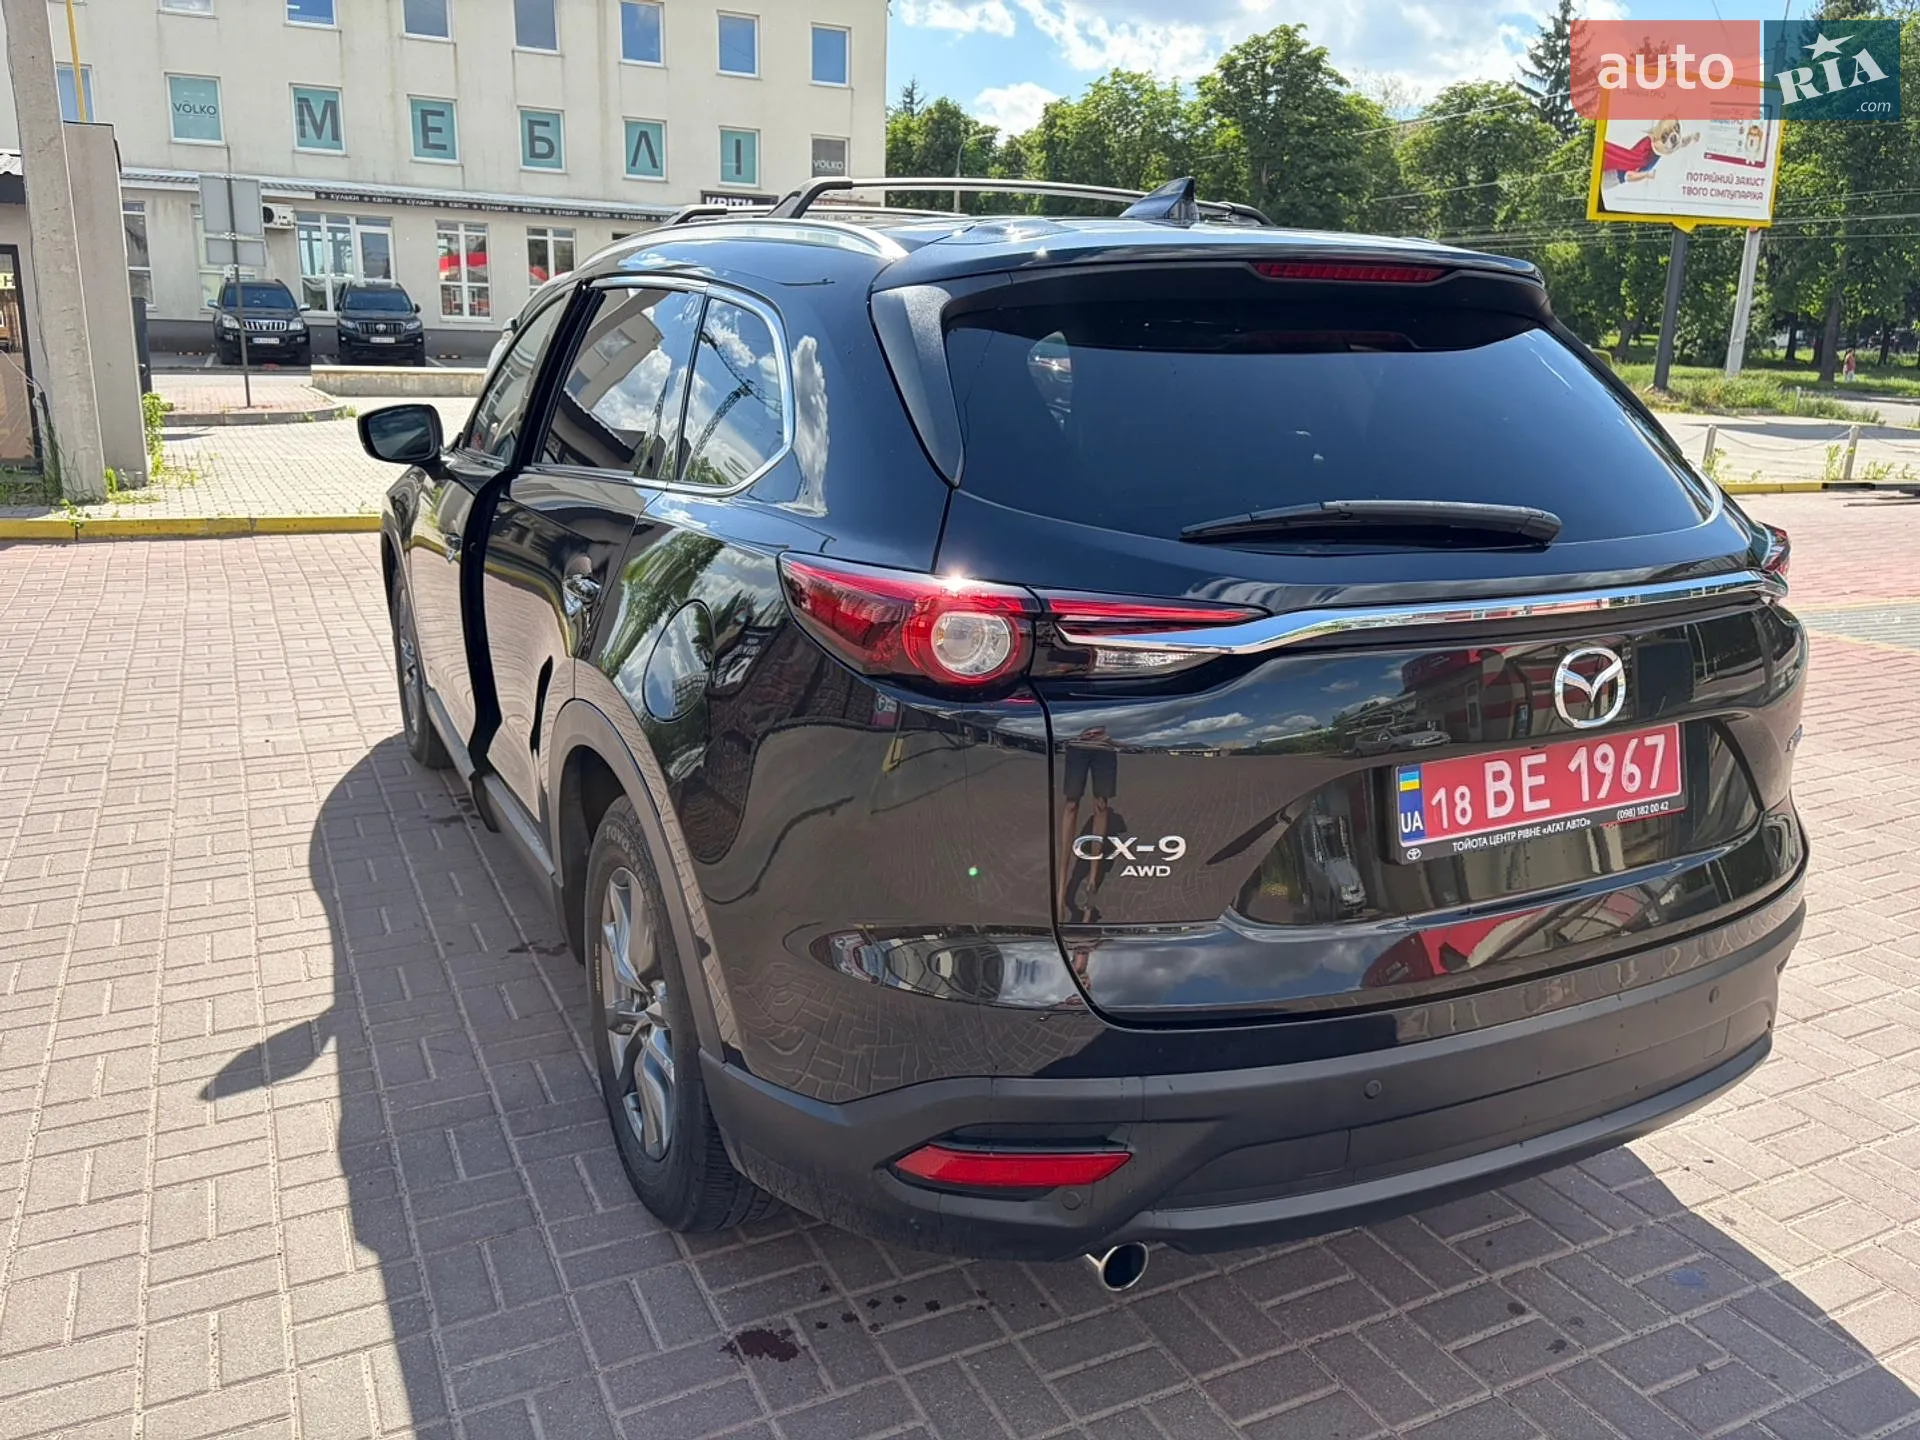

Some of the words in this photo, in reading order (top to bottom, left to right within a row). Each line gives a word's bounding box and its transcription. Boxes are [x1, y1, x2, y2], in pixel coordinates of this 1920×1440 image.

[1682, 186, 1708, 196] ТВОГО
[1431, 785, 1472, 829] 18
[1567, 734, 1665, 802] 1967
[1637, 804, 1649, 815] 182
[1660, 801, 1669, 811] 42
[1400, 811, 1424, 833] UA
[1072, 834, 1187, 862] CX-9
[1452, 837, 1488, 852] ТОЙОТА
[1489, 831, 1517, 846] ЦЕНТР
[1120, 865, 1171, 877] AWD
